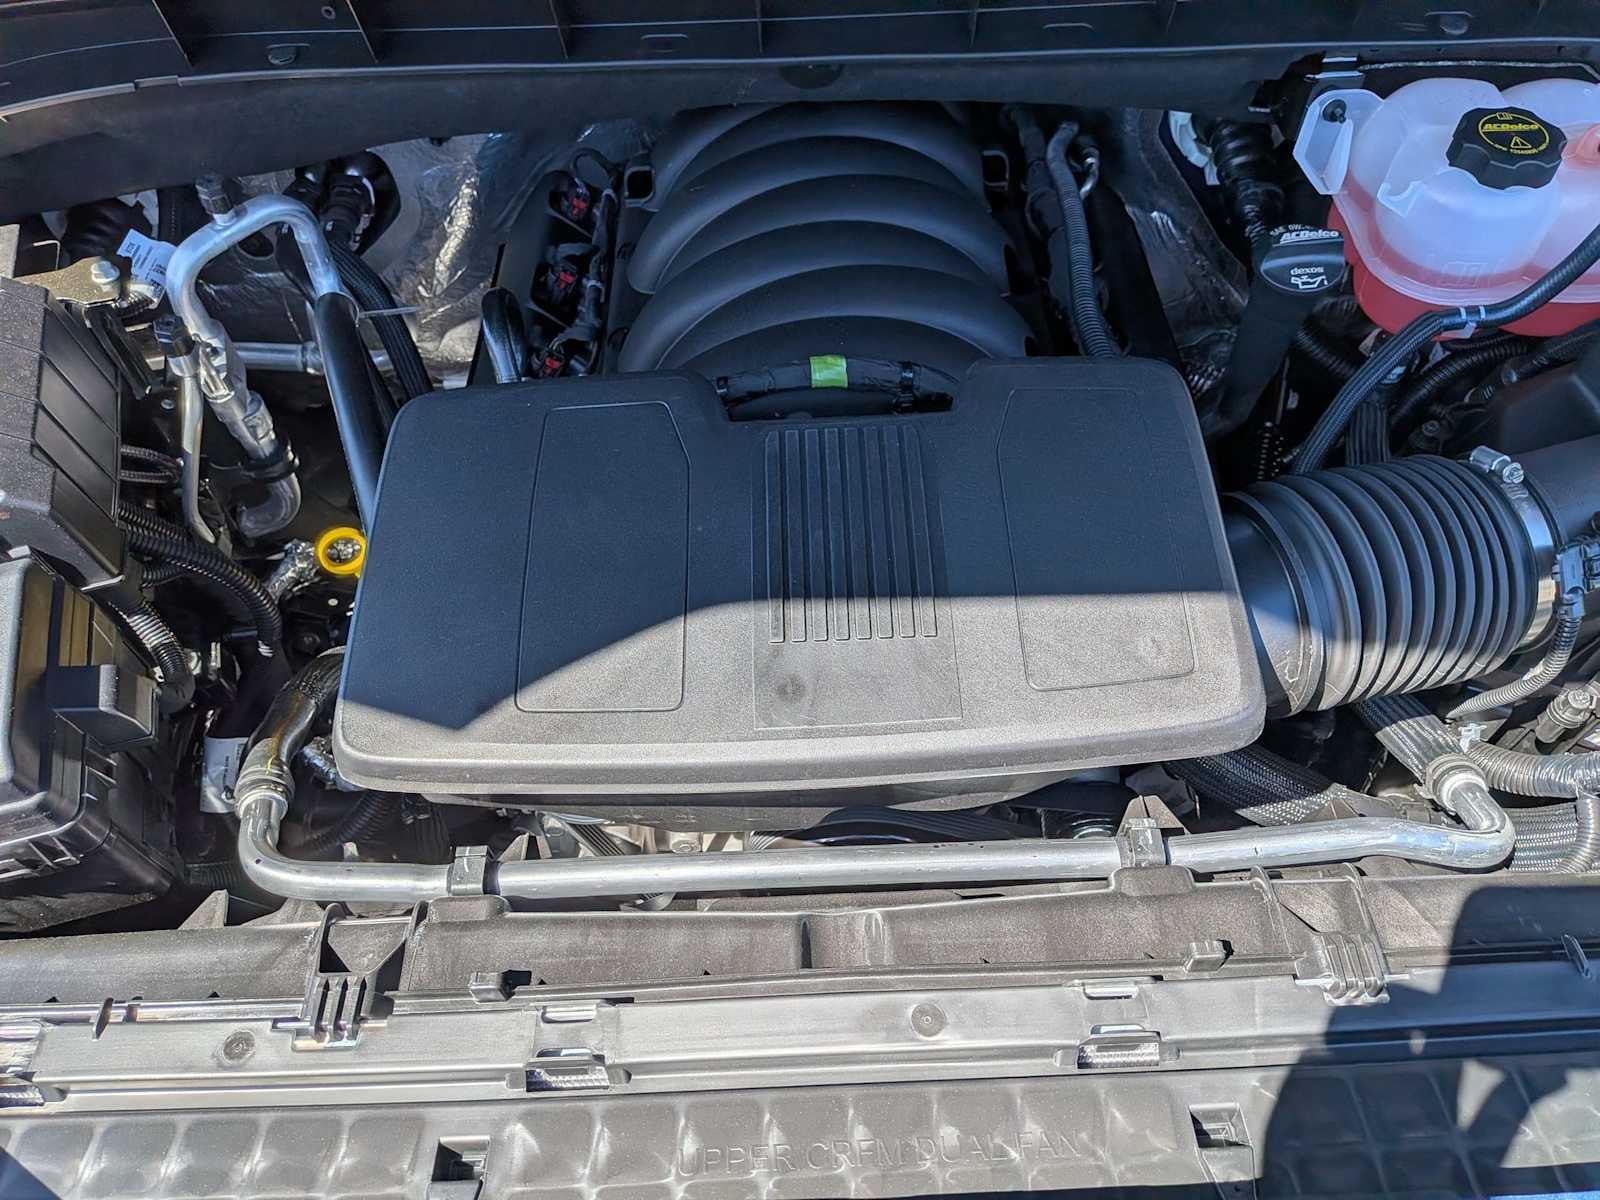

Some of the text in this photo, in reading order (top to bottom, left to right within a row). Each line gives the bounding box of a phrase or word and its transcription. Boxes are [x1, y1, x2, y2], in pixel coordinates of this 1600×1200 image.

[1483, 123, 1540, 131] ACDelco
[1280, 229, 1339, 242] ACDelco
[1290, 266, 1324, 275] dexos
[679, 1143, 796, 1177] UPPER
[914, 1132, 1009, 1163] DUAL
[1014, 1128, 1082, 1158] FAN
